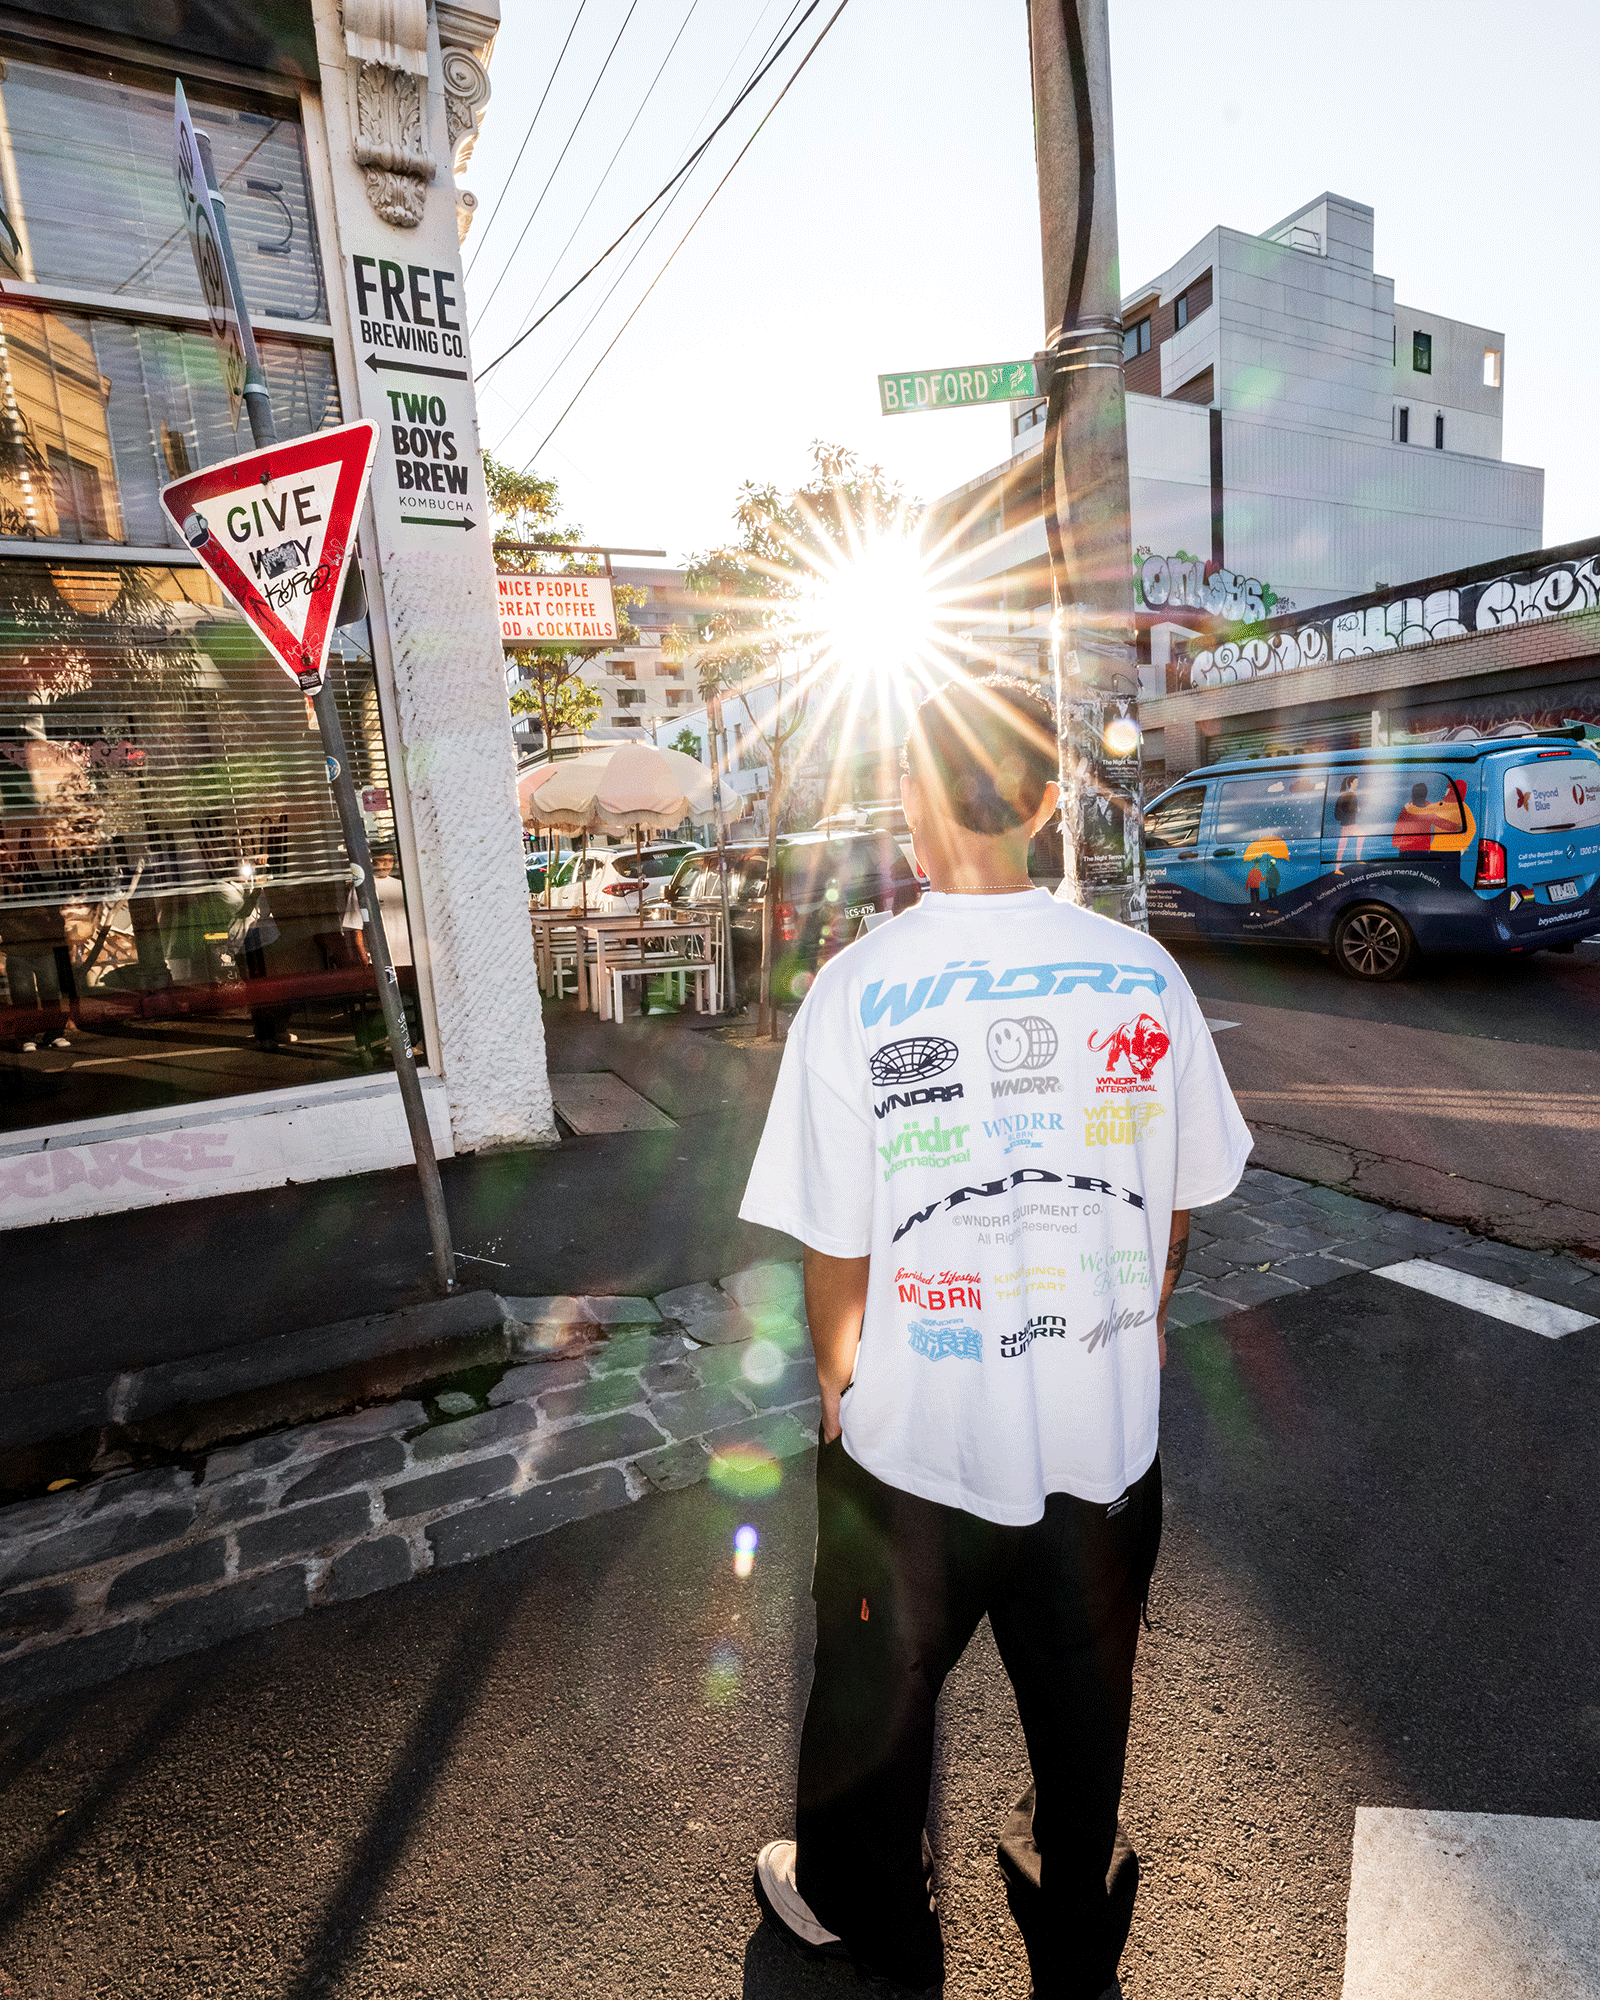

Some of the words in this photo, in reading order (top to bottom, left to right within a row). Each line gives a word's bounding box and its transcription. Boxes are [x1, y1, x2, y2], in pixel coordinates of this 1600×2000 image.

[352, 254, 460, 331] FREE
[360, 319, 439, 354] BREWING
[441, 333, 466, 359] CO.
[884, 370, 988, 410] BEDFORD
[991, 368, 1004, 384] ST
[387, 390, 447, 427] TWO
[392, 425, 457, 461] BOYS
[395, 459, 468, 495] BREW
[399, 496, 474, 512] KOMBUCHA
[227, 485, 322, 543] GIVE
[249, 536, 313, 580] WY
[498, 580, 532, 596] NICE
[537, 582, 589, 598] PEOPLE
[546, 602, 596, 617] COFFEE
[502, 621, 522, 636] OD
[527, 626, 533, 636] &
[537, 622, 612, 636] COCKTAILS
[1533, 787, 1559, 801] Beyond
[1535, 802, 1550, 811] Blue
[1537, 850, 1553, 858] Beyond
[1146, 867, 1167, 878] eyond
[1351, 874, 1365, 885] best
[1366, 869, 1392, 881] possible
[1394, 868, 1419, 876] mental
[1538, 908, 1590, 926] beyondblue.org.au
[1096, 1077, 1138, 1085] WNDRR
[874, 1083, 964, 1119] WNDRR
[981, 1112, 1065, 1138] WNDRR
[1082, 1203, 1103, 1216] CO.
[978, 1232, 991, 1245] All
[894, 1267, 935, 1285] Enriched
[937, 1269, 981, 1286] Lifestyle
[1025, 1266, 1066, 1277] SINCE
[898, 1284, 981, 1311] MLBRN
[996, 1286, 1021, 1300] THE
